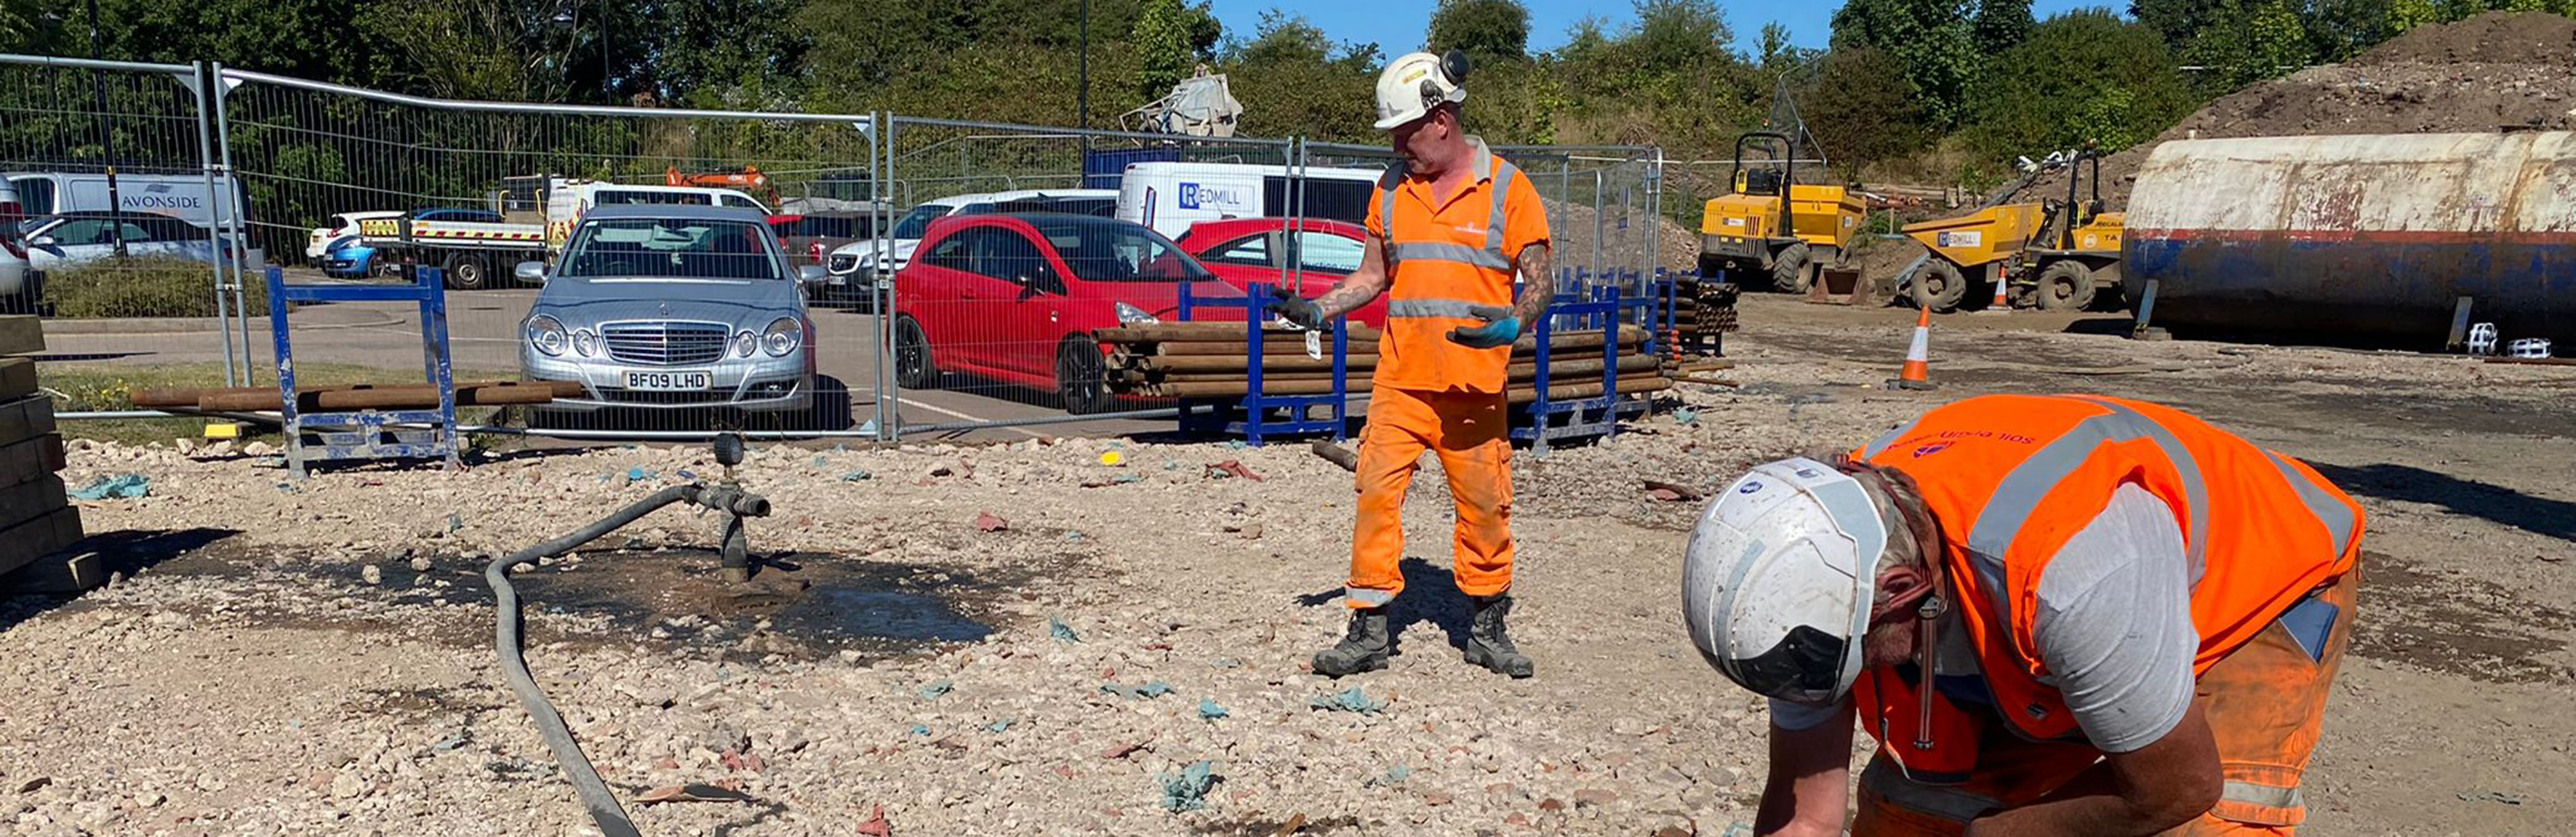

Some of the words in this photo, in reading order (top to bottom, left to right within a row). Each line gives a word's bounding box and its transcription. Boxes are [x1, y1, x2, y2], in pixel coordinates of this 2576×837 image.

[122, 196, 201, 208] AVONSIDE
[1181, 184, 1240, 207] REDMILL
[629, 373, 670, 388] BF09
[674, 373, 705, 388] LHD
